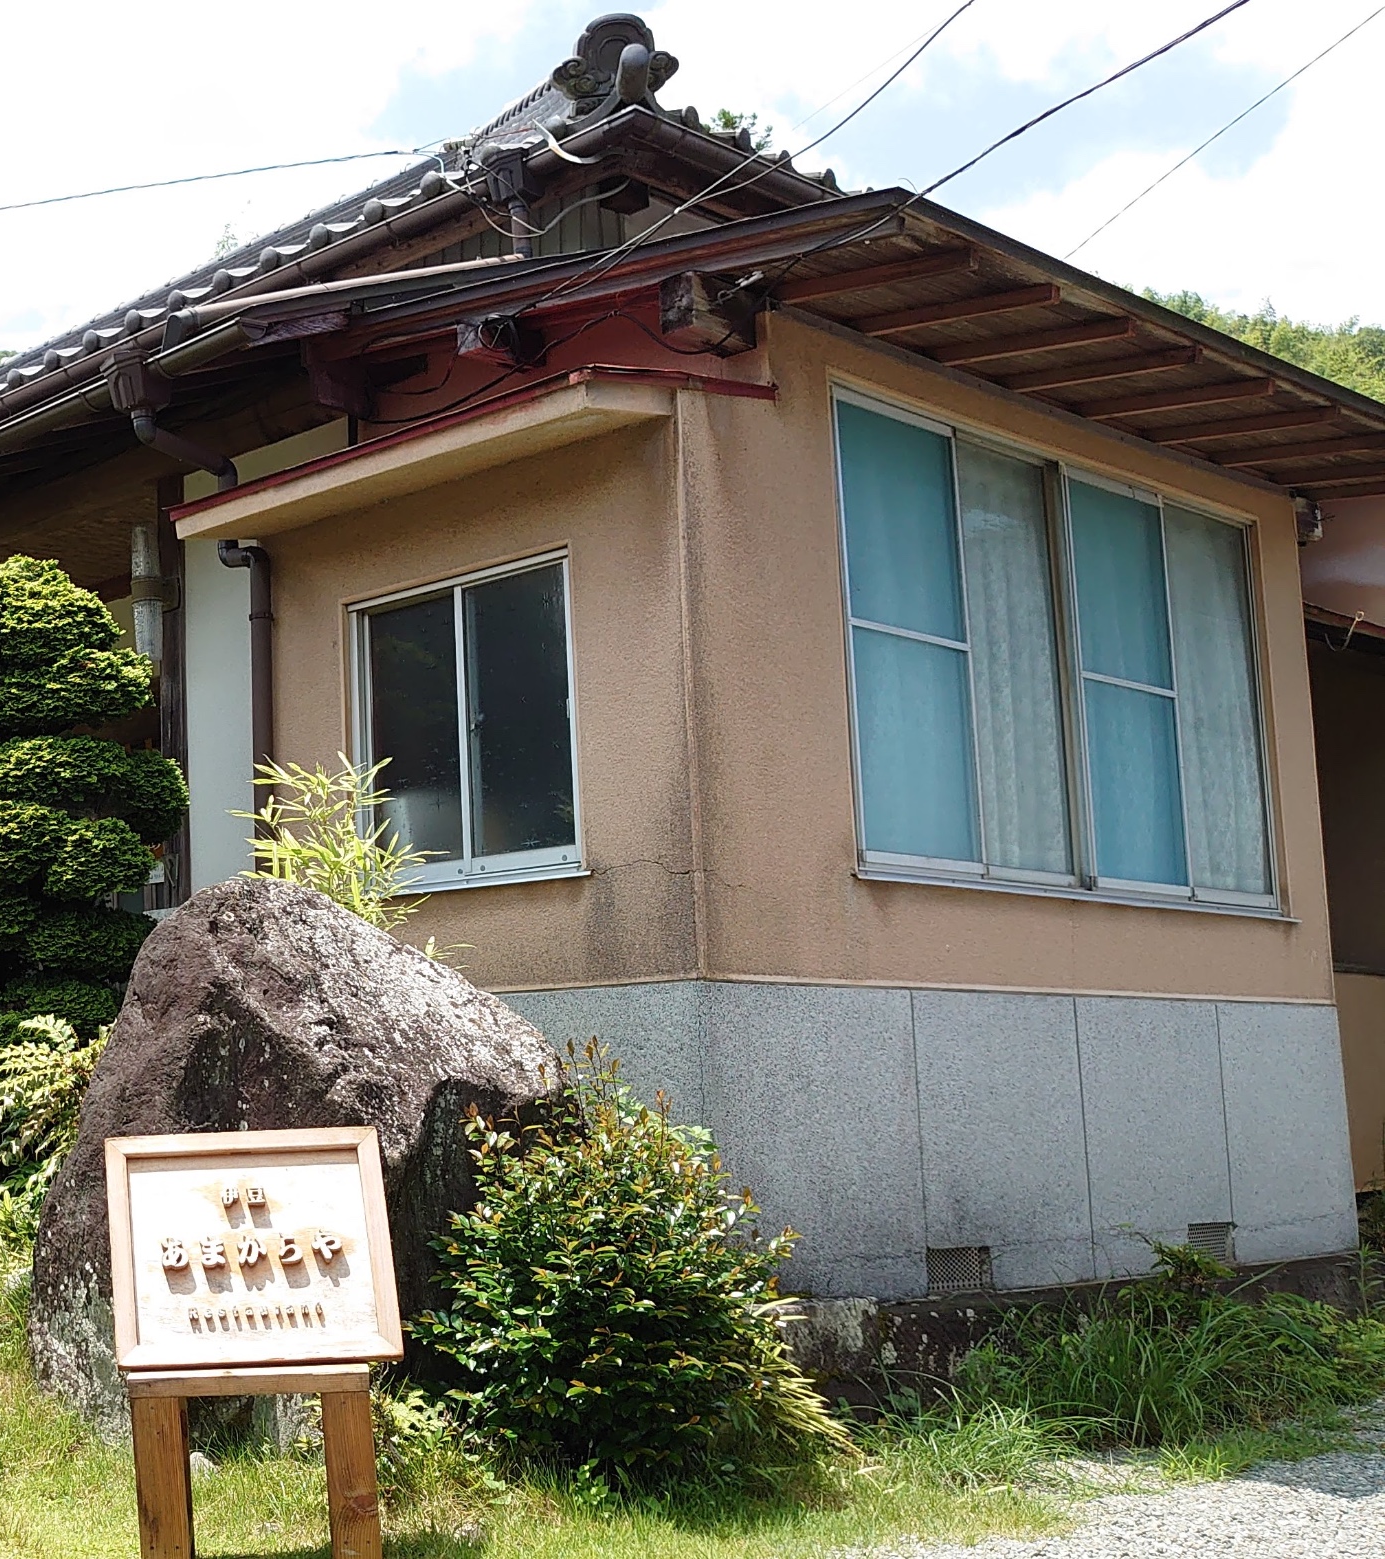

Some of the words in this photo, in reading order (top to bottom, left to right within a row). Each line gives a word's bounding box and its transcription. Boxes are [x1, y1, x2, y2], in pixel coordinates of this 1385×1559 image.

[221, 1187, 266, 1207] 伊豆
[161, 1229, 343, 1270] あまからや
[188, 1303, 324, 1321] Restaurant
